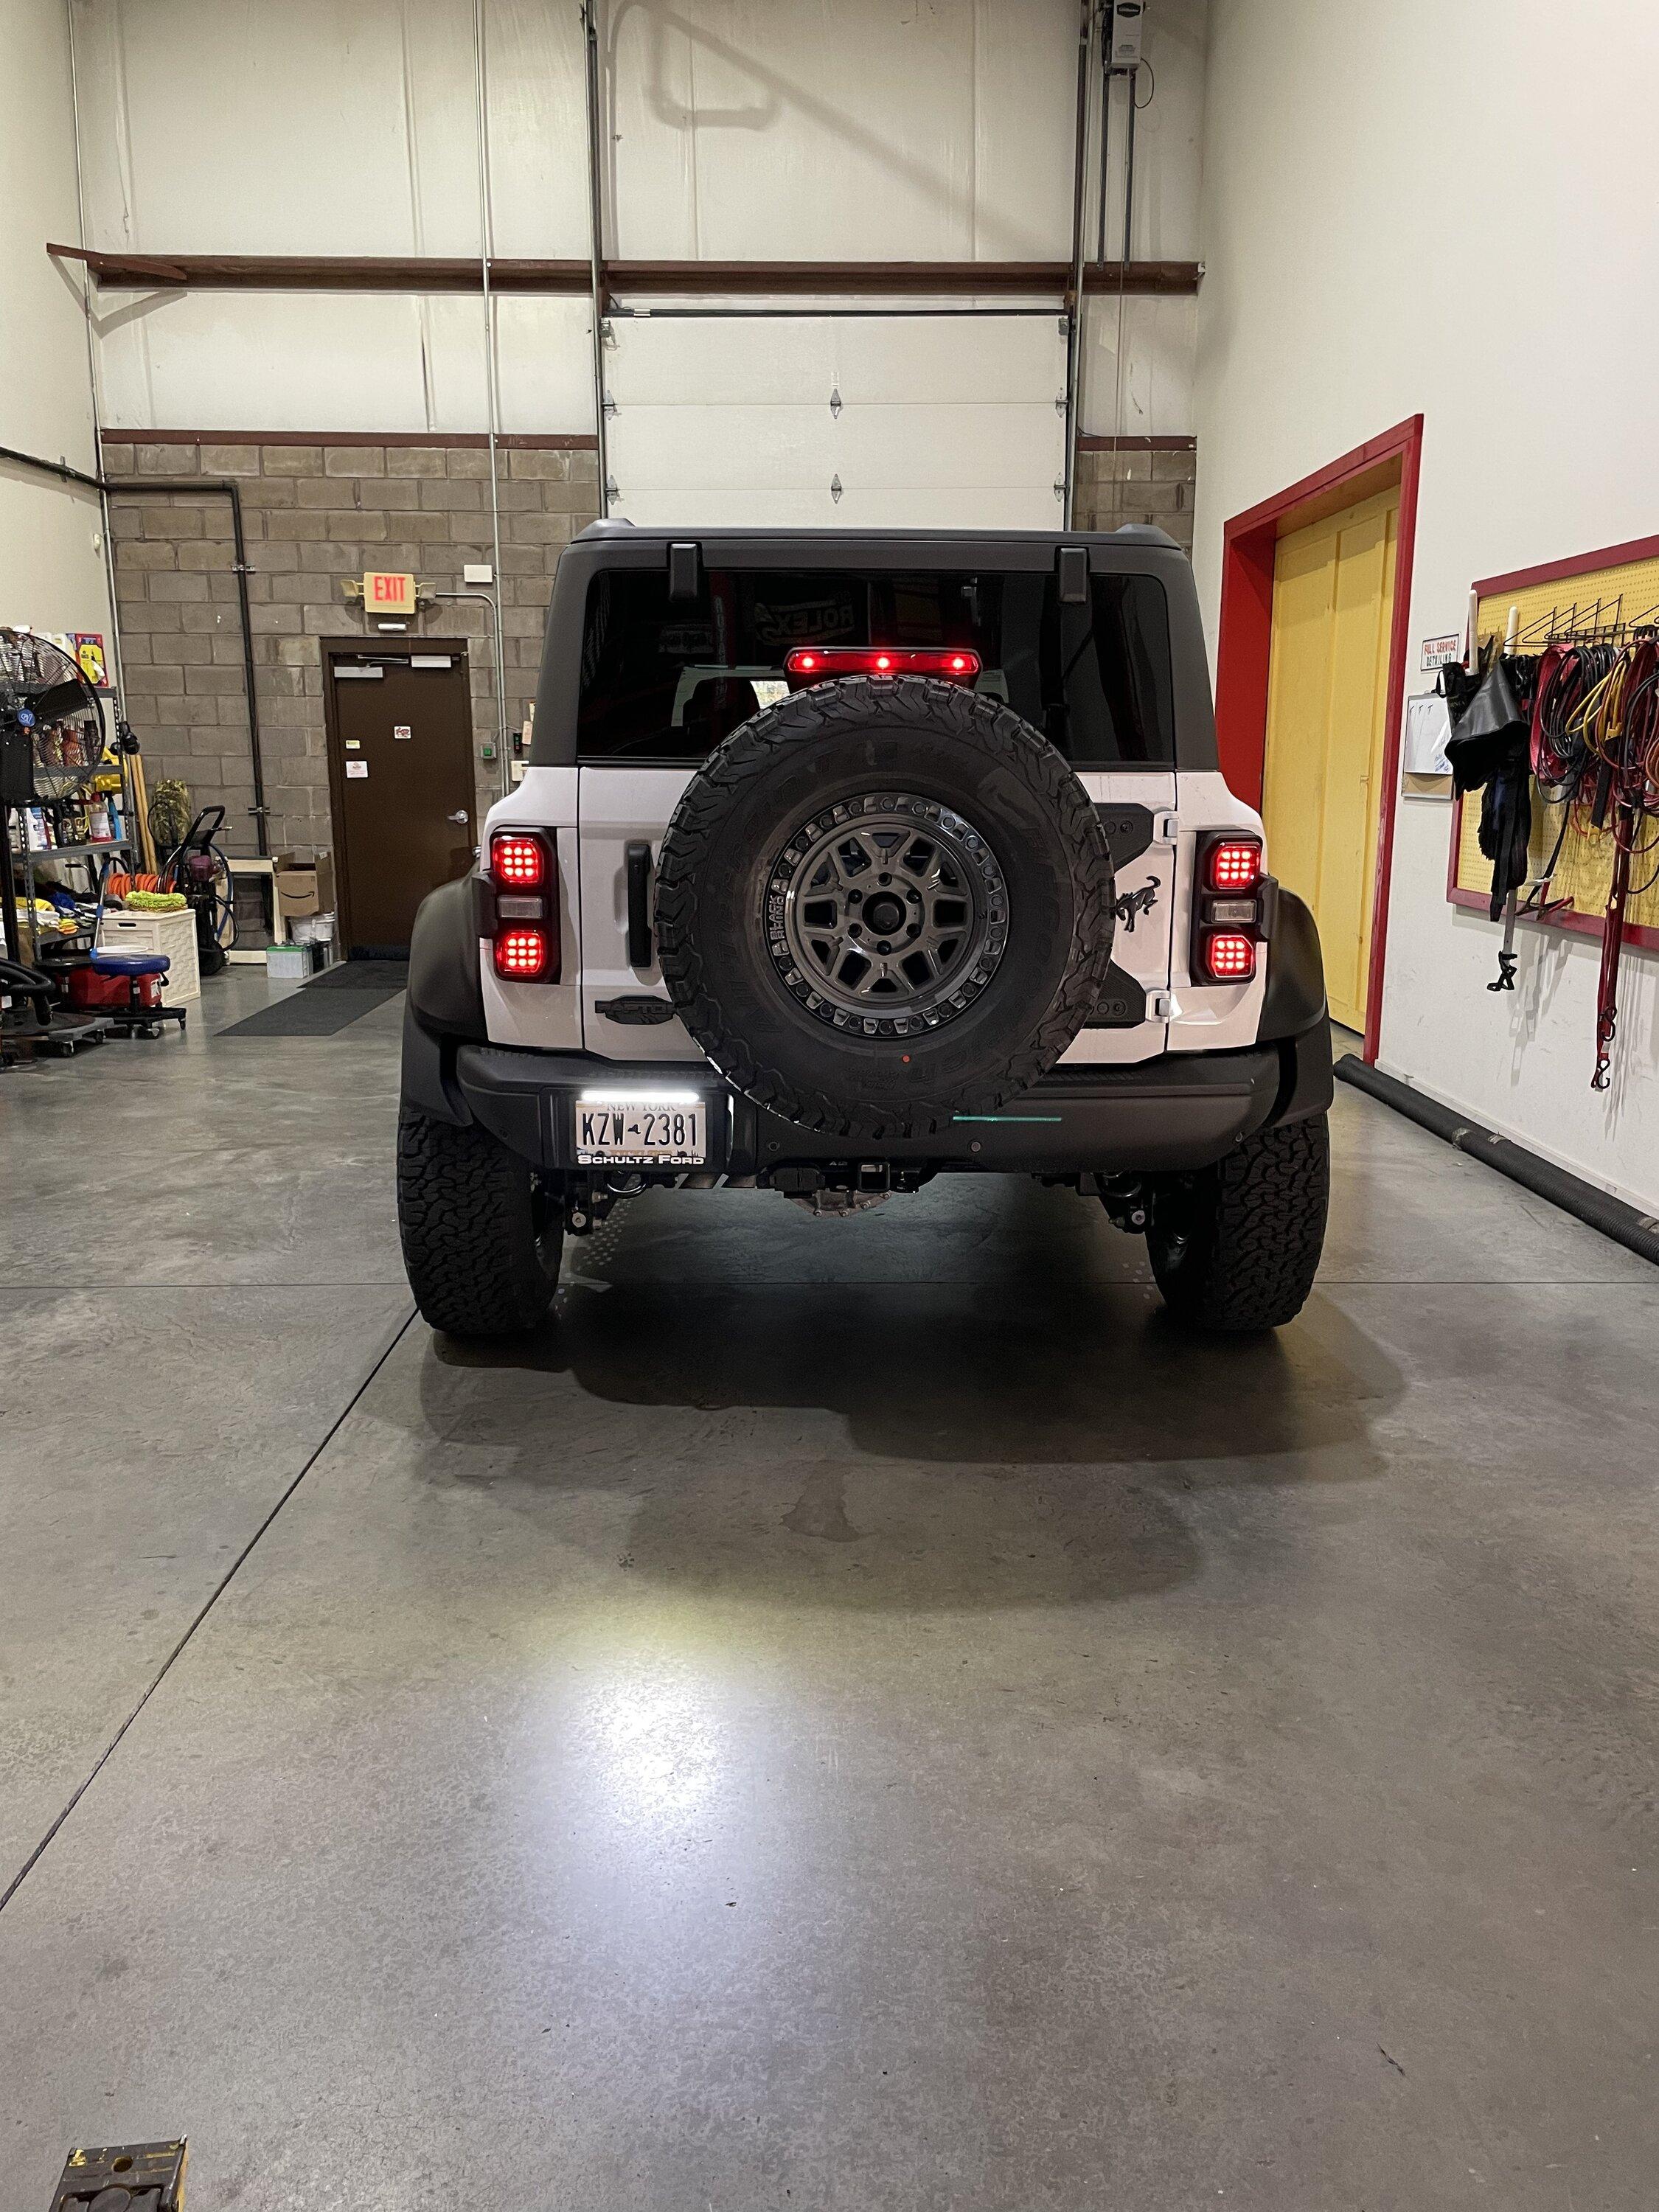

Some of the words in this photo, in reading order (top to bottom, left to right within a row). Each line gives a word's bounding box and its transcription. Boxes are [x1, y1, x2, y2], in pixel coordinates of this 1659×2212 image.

[374, 576, 406, 602] EXIT
[1437, 639, 1456, 653] SERVICE
[769, 895, 778, 940] BLACK
[776, 896, 785, 939] RHINO
[607, 1102, 636, 1111] NEW
[642, 1102, 677, 1112] YORK
[582, 1113, 625, 1146] KZW
[643, 1113, 697, 1147] 2381
[577, 1154, 654, 1165] SCHULTZ
[658, 1154, 705, 1165] FORD
